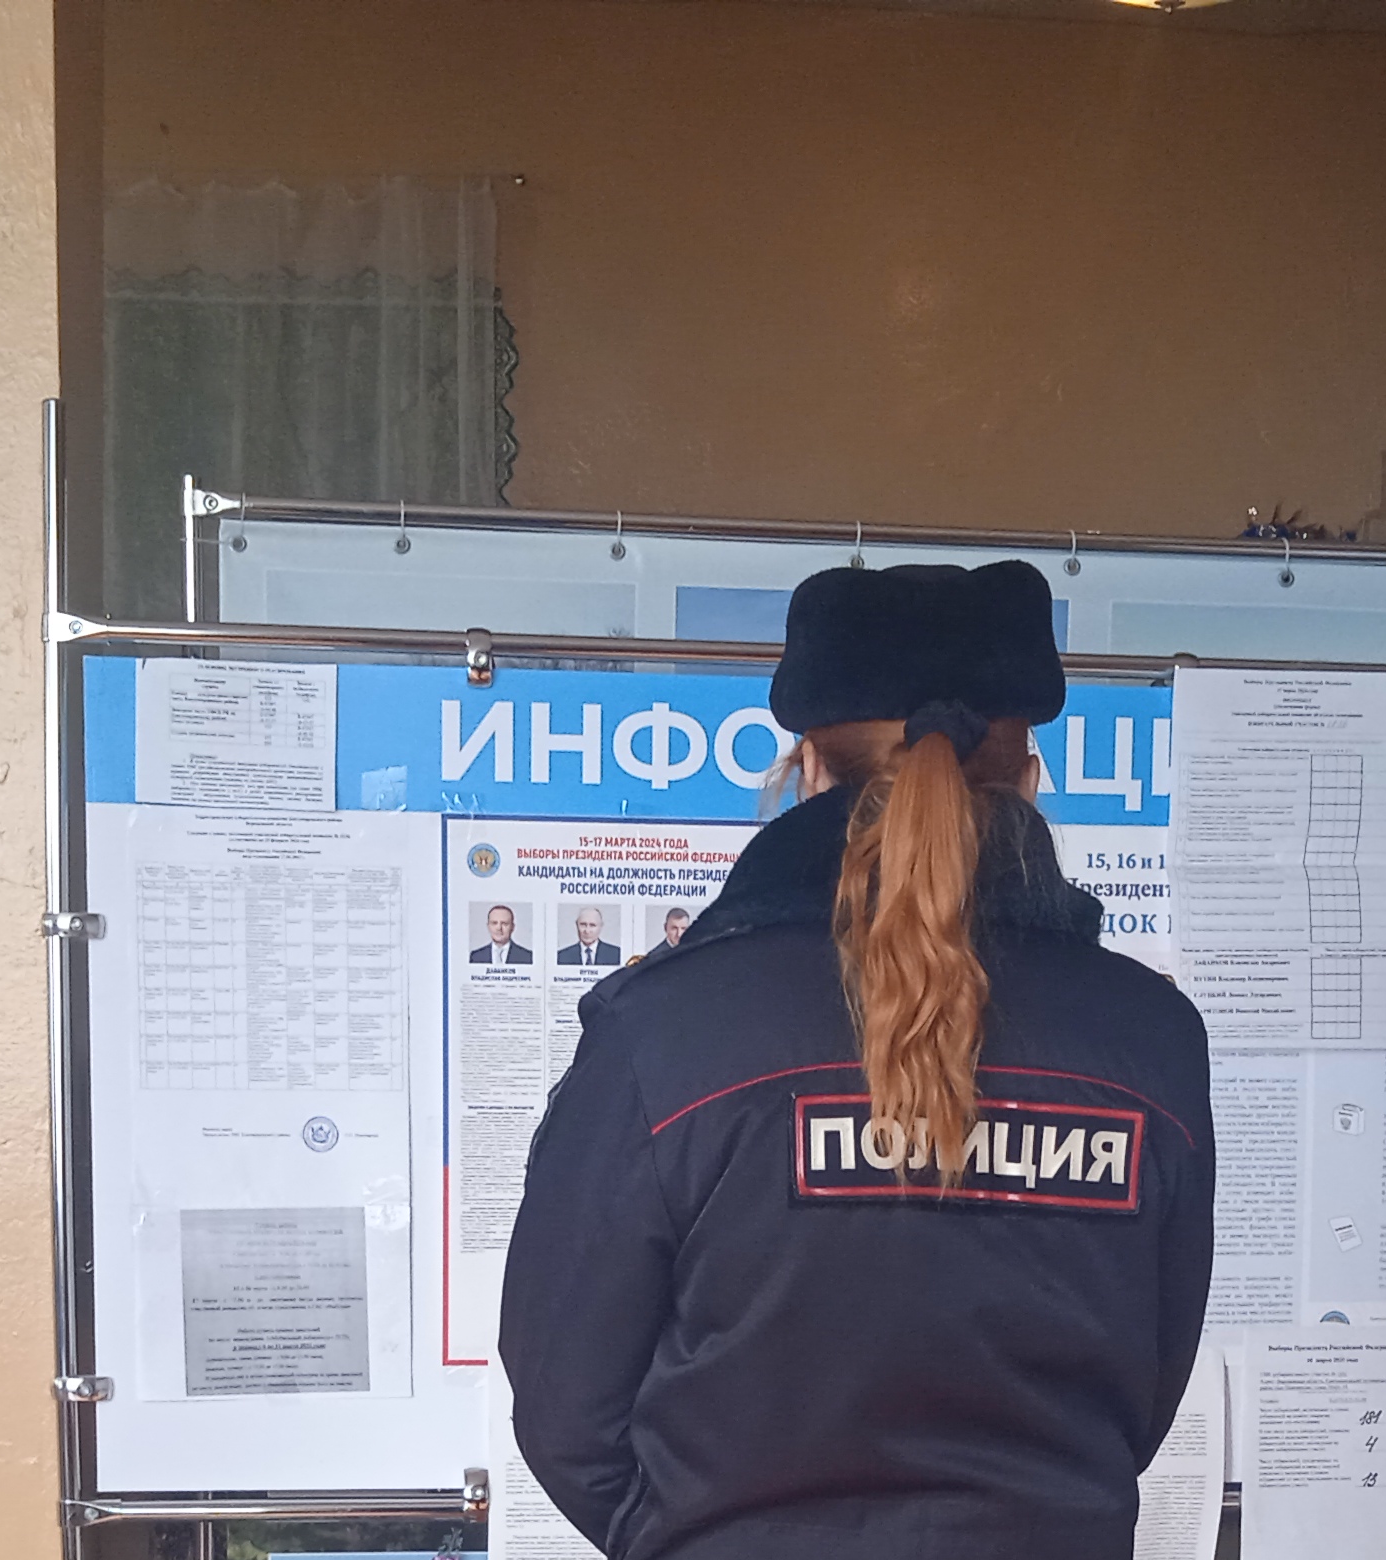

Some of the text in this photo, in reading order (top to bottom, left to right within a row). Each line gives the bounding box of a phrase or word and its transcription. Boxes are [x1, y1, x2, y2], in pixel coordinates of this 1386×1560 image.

[604, 837, 637, 848] МАРТА
[638, 838, 662, 849] 2024
[663, 838, 689, 849] ГОДА
[516, 848, 740, 864] ВЫБОРЫ ПРЕЗИДЕНТА РОССИЙСКОЙ ФЕДЕРАЦ
[1087, 853, 1111, 871] 15,
[1117, 853, 1136, 869] 16
[1140, 857, 1152, 869] и
[517, 864, 729, 882] КАНДИДАТЫ НА ДОЛЖНОСТЬ ПРЕЗИДЕ
[559, 880, 707, 898] РОССИЙСКОЙ ФЕДЕРАЦИИ
[1365, 1435, 1379, 1453] 4
